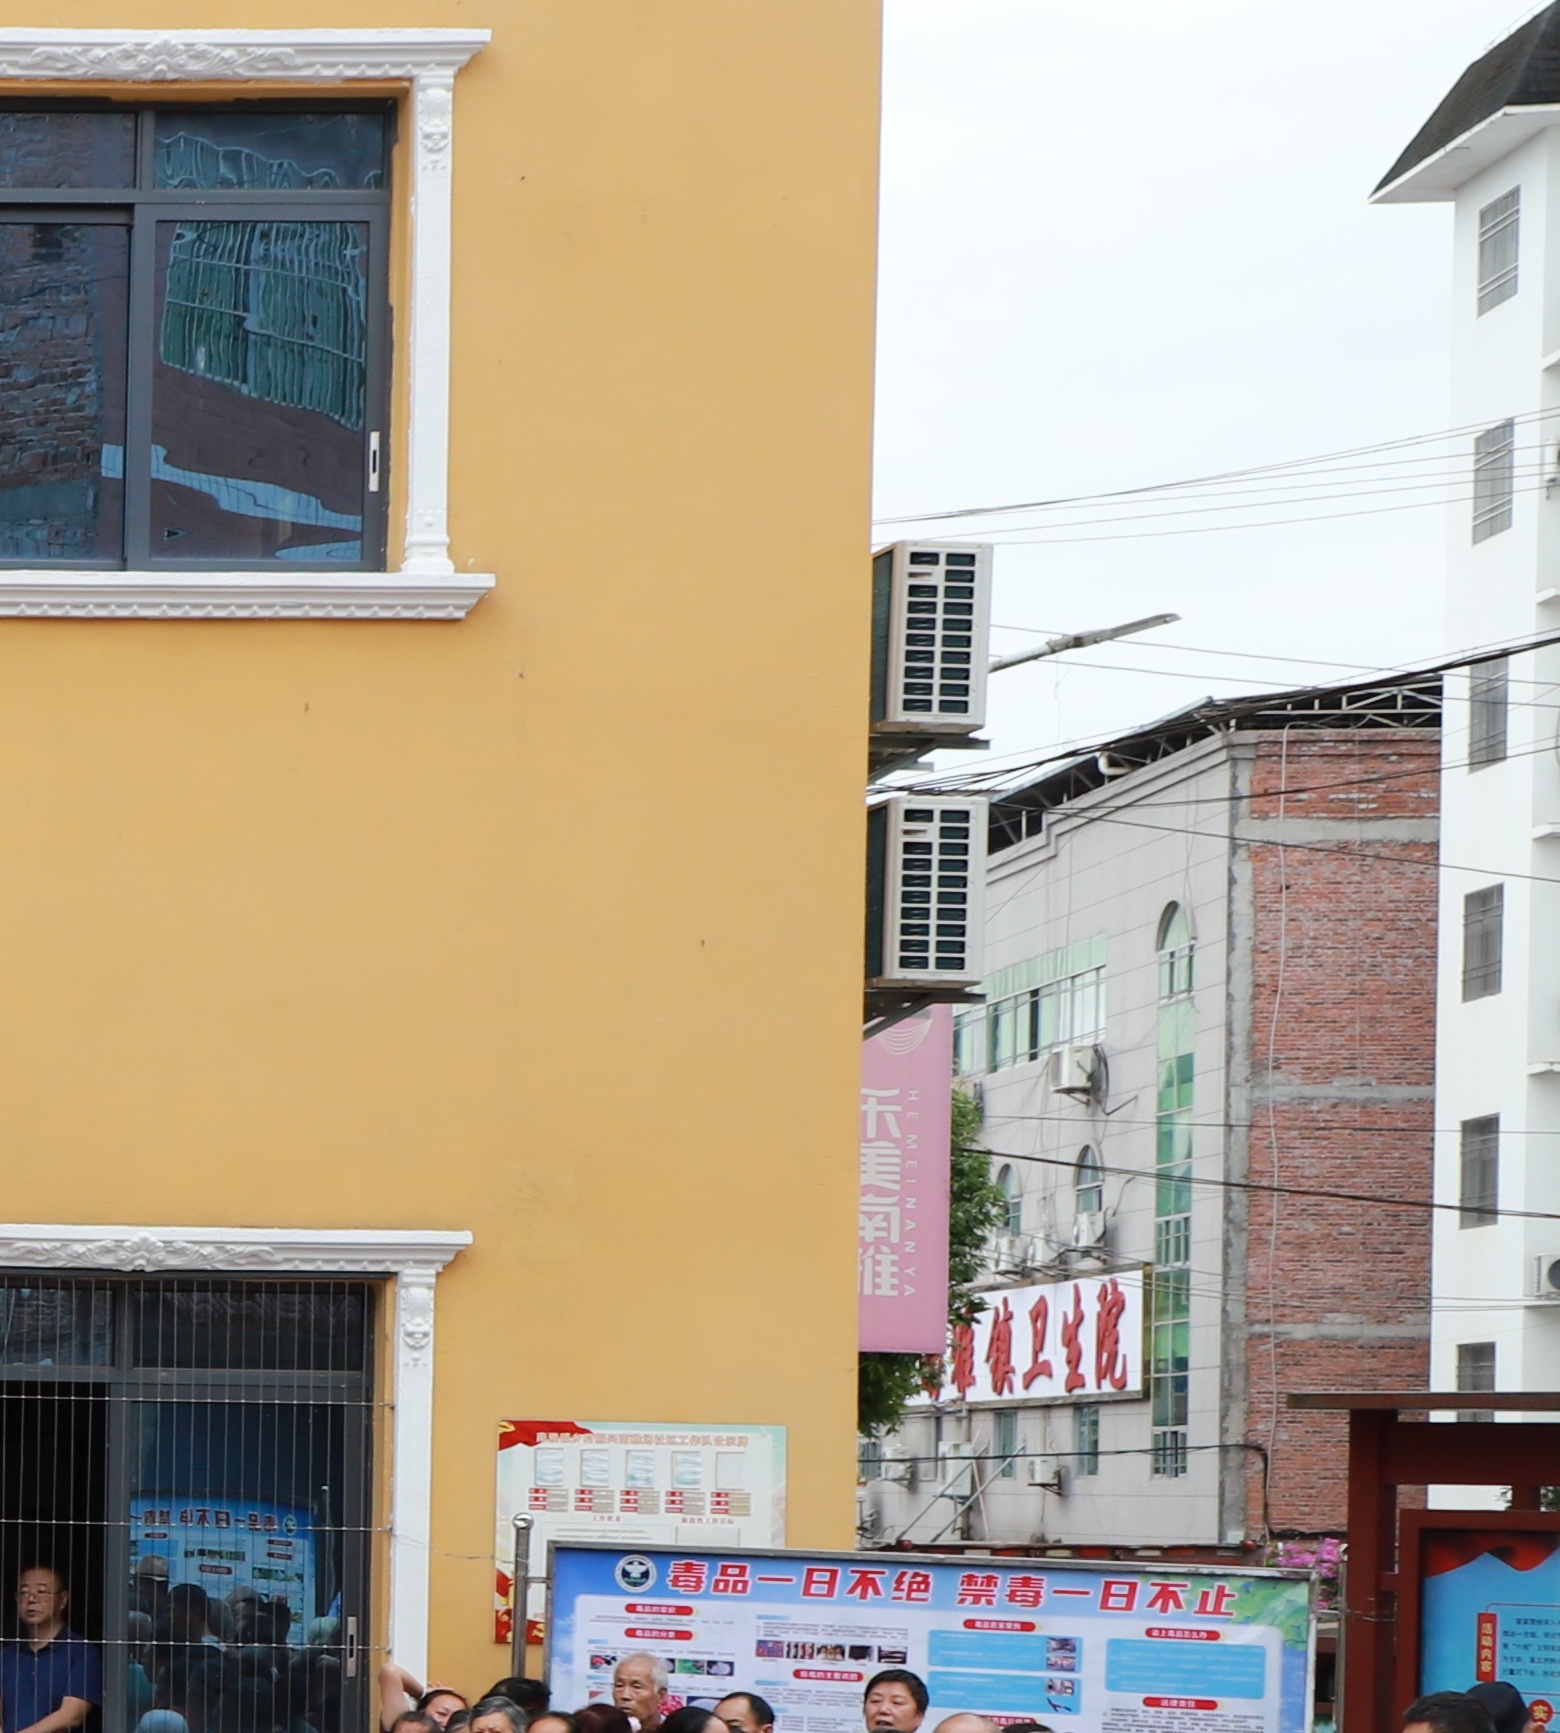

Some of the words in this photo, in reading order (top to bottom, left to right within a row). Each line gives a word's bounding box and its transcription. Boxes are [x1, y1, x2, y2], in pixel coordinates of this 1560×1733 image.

[923, 1278, 1127, 1401] 雅镇卫生院
[667, 1559, 933, 1603] 毒品一日不绝
[957, 1572, 1239, 1618] 禁毒一日不止
